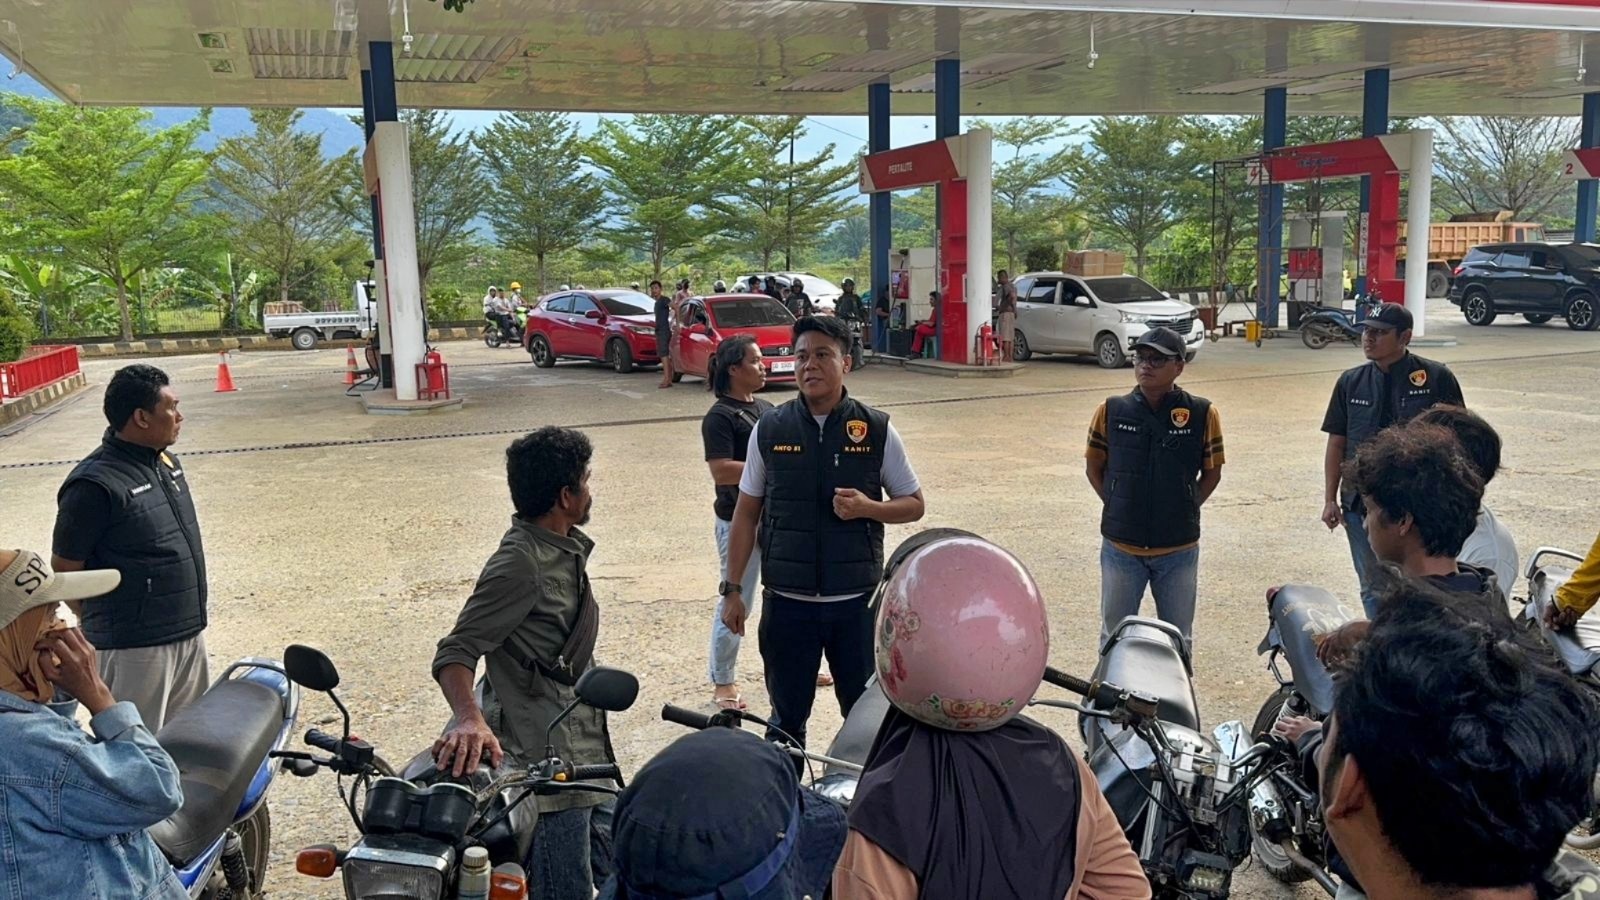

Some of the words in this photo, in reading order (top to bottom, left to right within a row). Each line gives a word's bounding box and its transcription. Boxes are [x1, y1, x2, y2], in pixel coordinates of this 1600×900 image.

[888, 161, 913, 174] PERTALITE
[1250, 166, 1258, 177] 4
[1565, 163, 1574, 174] 2
[1118, 424, 1136, 432] PAUL
[15, 552, 48, 595] SP
